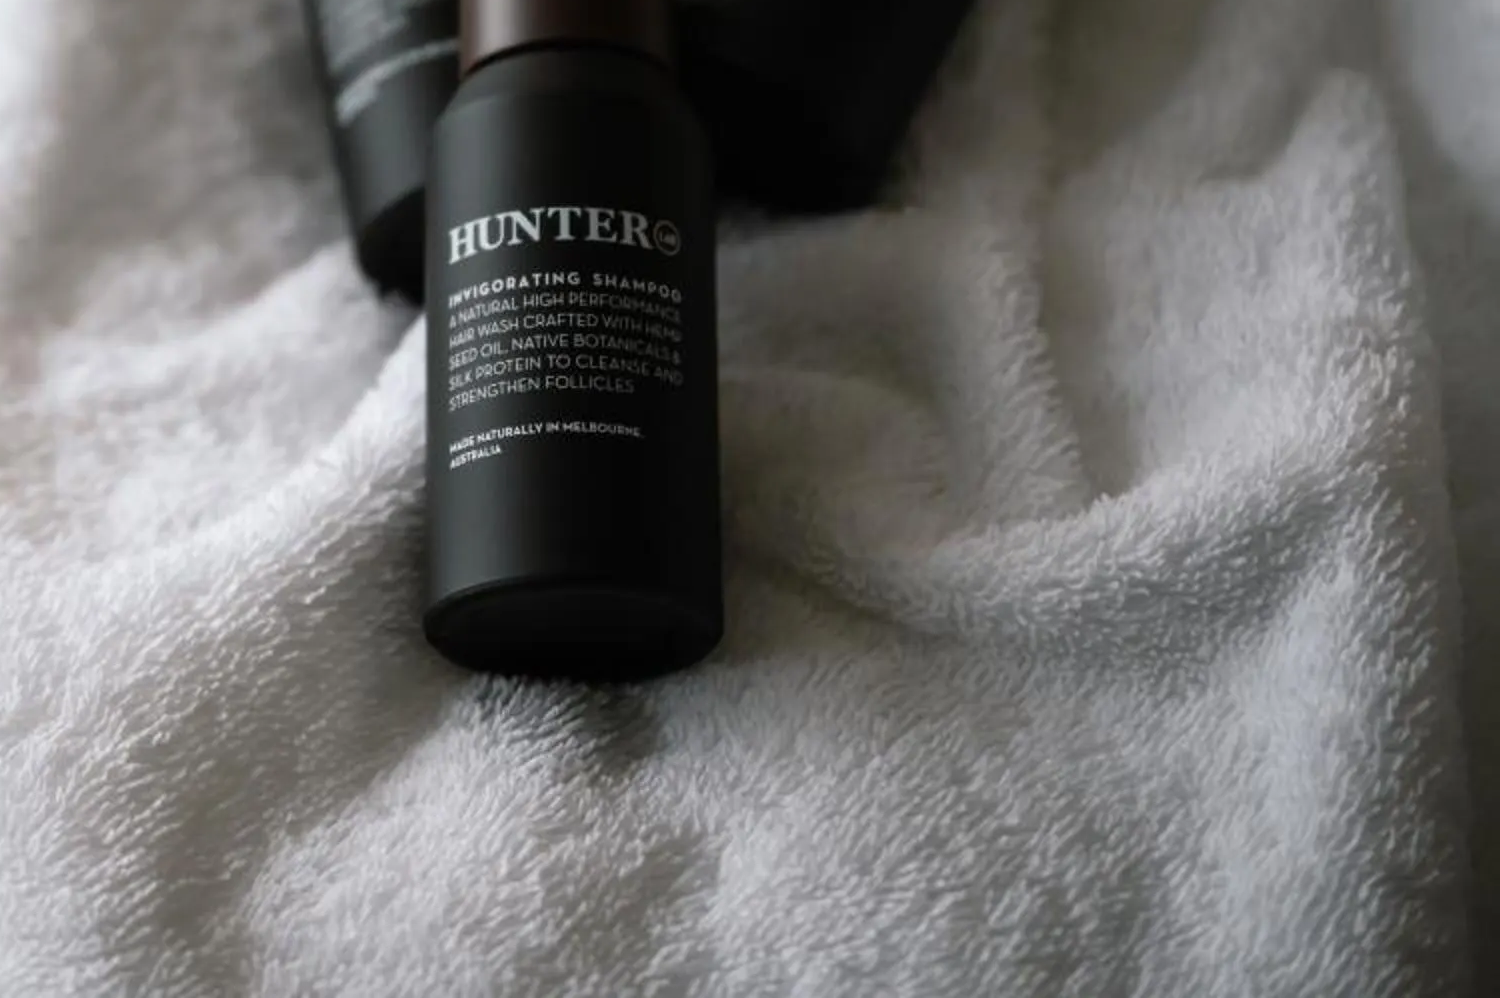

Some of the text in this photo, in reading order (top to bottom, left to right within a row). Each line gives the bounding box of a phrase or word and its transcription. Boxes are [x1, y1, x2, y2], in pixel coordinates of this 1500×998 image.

[450, 206, 652, 264] HUNTER
[450, 271, 682, 308] INVIGORATING SHAMPOO
[449, 314, 457, 329] A
[458, 298, 518, 323] NATURAL
[523, 292, 564, 308] HIGH
[449, 328, 474, 350] HAIR
[478, 317, 519, 337] WASH
[523, 313, 599, 329] CRAFTED
[602, 313, 642, 331] WITH
[449, 348, 478, 371] SEED
[511, 334, 569, 350] NATIVE
[573, 333, 669, 361] BOTANICALS
[449, 354, 683, 392] SILK PROTEIN TO CLEANSE AND
[449, 375, 636, 413] STRENGTHEN FOLLICLES
[449, 435, 475, 455] MADE
[477, 421, 543, 444] NATURALLY
[545, 420, 560, 433] IN
[449, 444, 502, 470] AUSTRALIA
